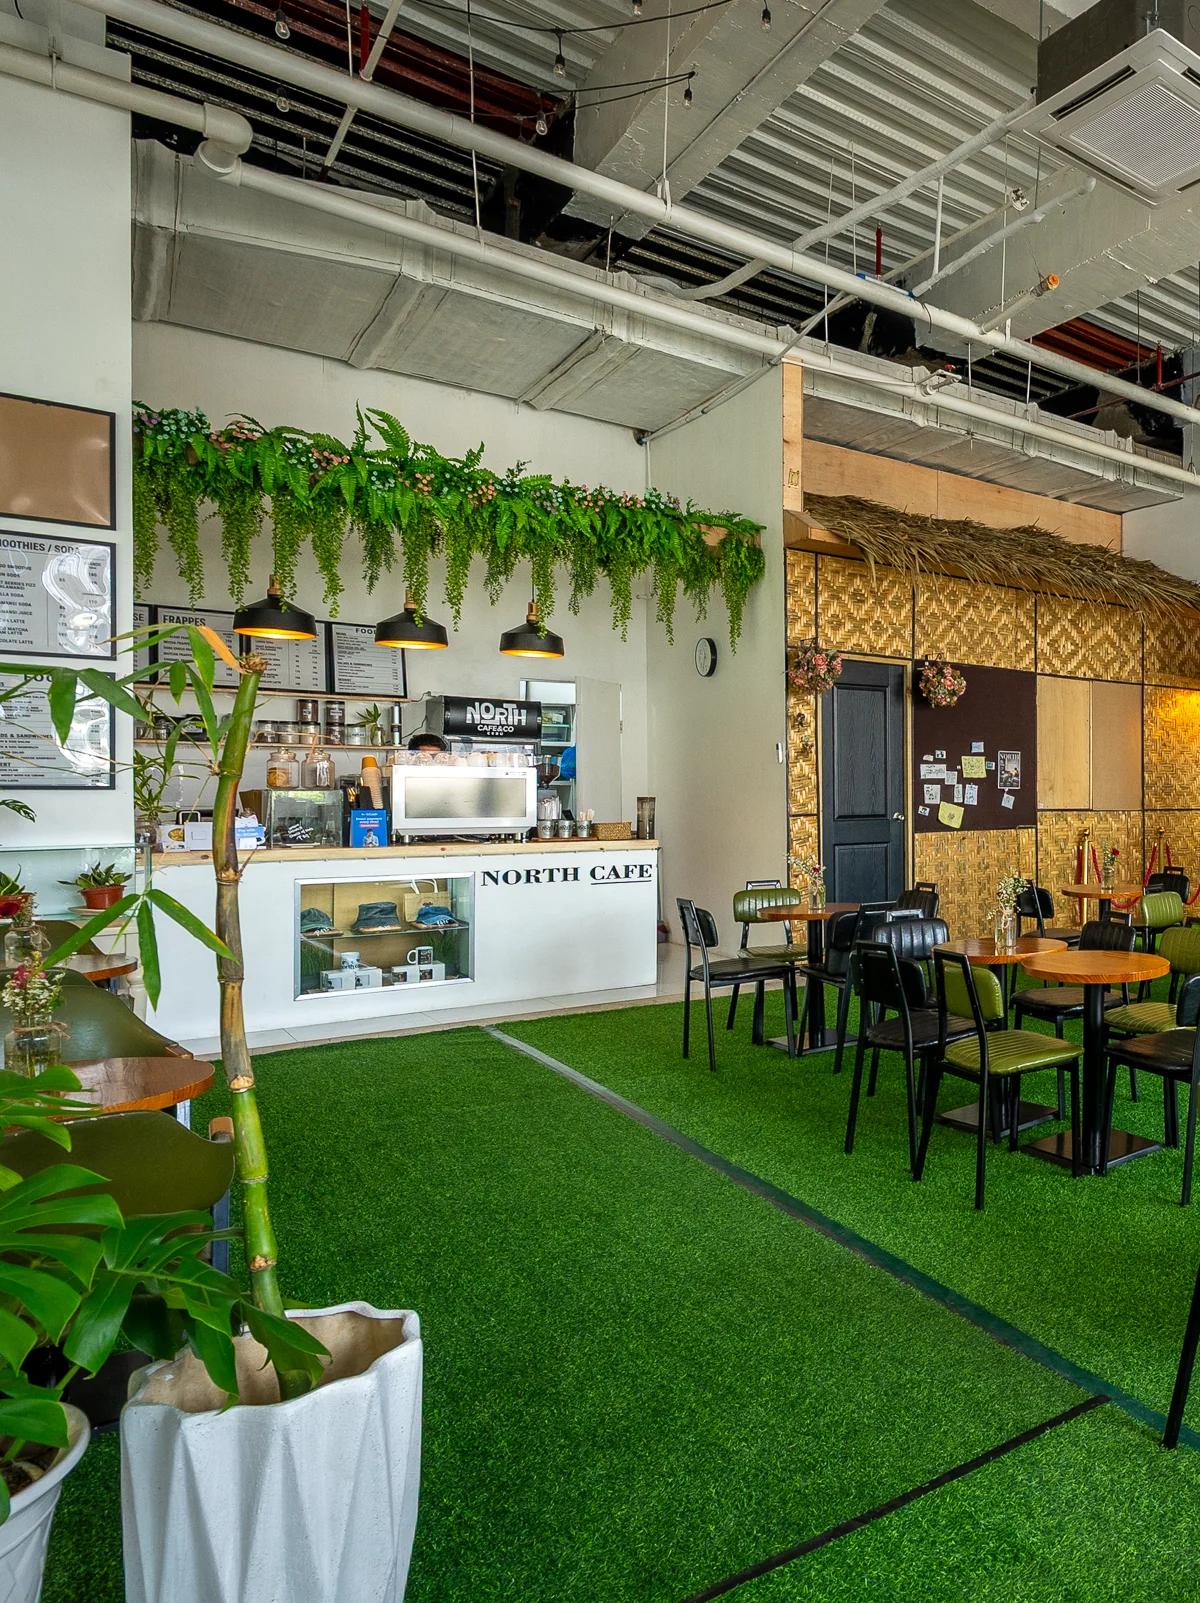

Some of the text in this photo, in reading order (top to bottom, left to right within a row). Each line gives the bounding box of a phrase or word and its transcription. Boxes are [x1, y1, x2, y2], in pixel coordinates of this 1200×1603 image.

[0, 538, 45, 551] OOTHIES
[163, 614, 206, 627] FRAPPES
[465, 701, 527, 726] NORTH
[477, 724, 514, 733] CAFE&CO
[480, 863, 653, 887] NORTH CAFE
